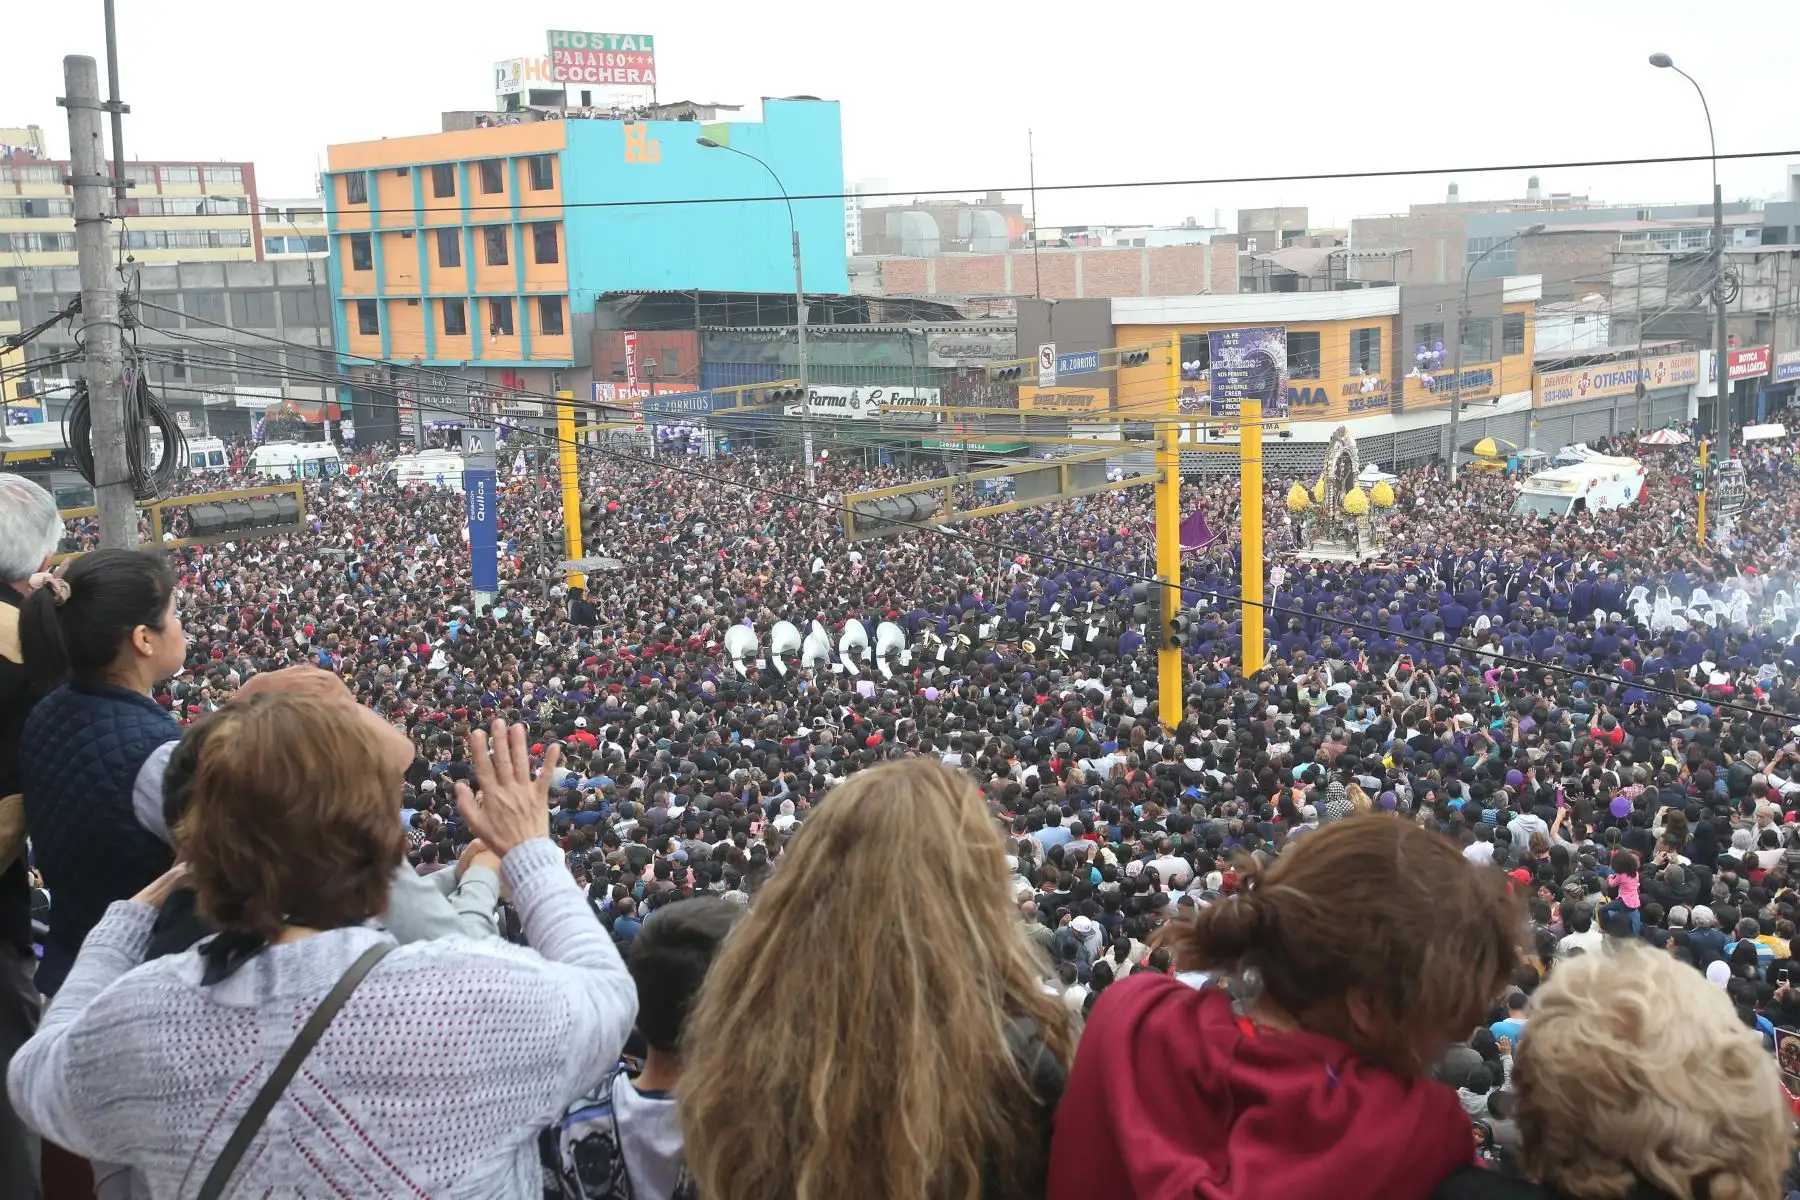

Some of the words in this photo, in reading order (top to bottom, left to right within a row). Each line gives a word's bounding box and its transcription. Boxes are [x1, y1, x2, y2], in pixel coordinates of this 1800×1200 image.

[553, 31, 652, 51] HOSTAL
[554, 50, 625, 67] PARAISO
[554, 66, 655, 82] COCHERA
[1069, 356, 1097, 371] ZORRITOS
[1671, 357, 1694, 369] DELIVERY
[1738, 352, 1758, 363] BOTICA
[1545, 375, 1573, 388] DELIVERY
[1594, 367, 1652, 389] OTIFARMA
[809, 391, 847, 407] Farma
[477, 481, 485, 522] Quilca
